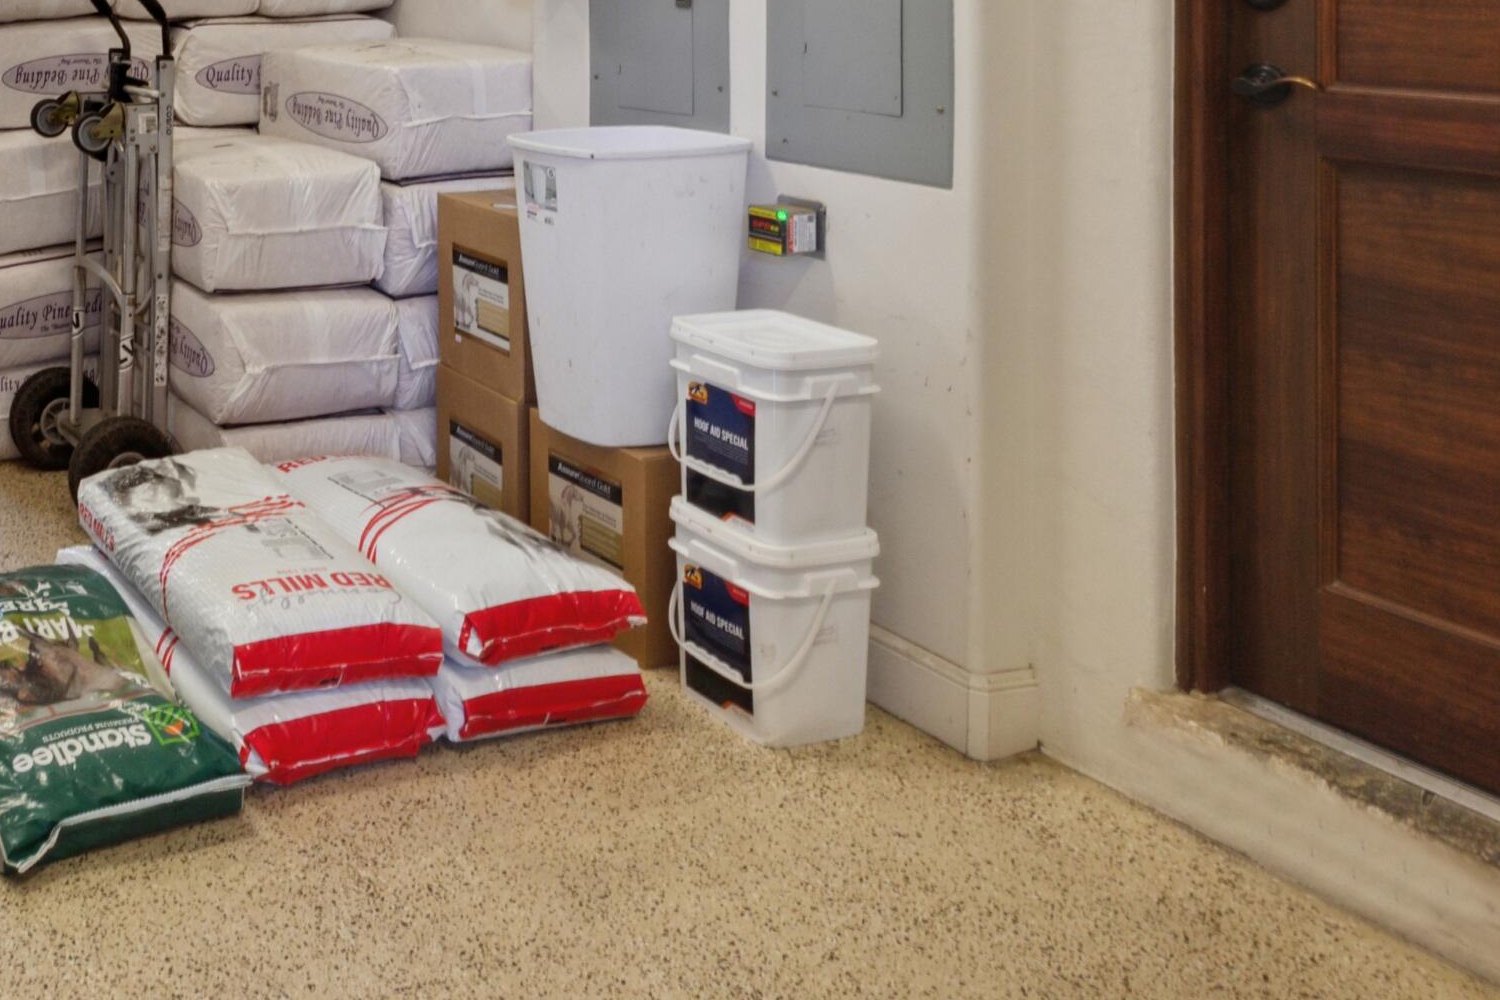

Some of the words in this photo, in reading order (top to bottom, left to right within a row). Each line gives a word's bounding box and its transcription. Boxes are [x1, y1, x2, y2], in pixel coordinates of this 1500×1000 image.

[14, 64, 68, 90] Bedding
[72, 67, 100, 86] Pine
[206, 62, 253, 89] Quality
[292, 95, 322, 126] Bedding
[325, 109, 343, 130] Pine
[345, 107, 380, 138] Quality
[42, 302, 71, 321] Pine
[180, 335, 208, 376] Quality
[693, 416, 710, 433] HOOF
[710, 424, 721, 439] AID
[721, 429, 749, 451] SPECIAL
[231, 574, 329, 601] MILLS
[329, 572, 394, 591] RED
[705, 609, 716, 625] AID
[716, 616, 745, 641] SPECIAL
[42, 724, 95, 743] PRODUCTS
[11, 723, 153, 773] Standlee
